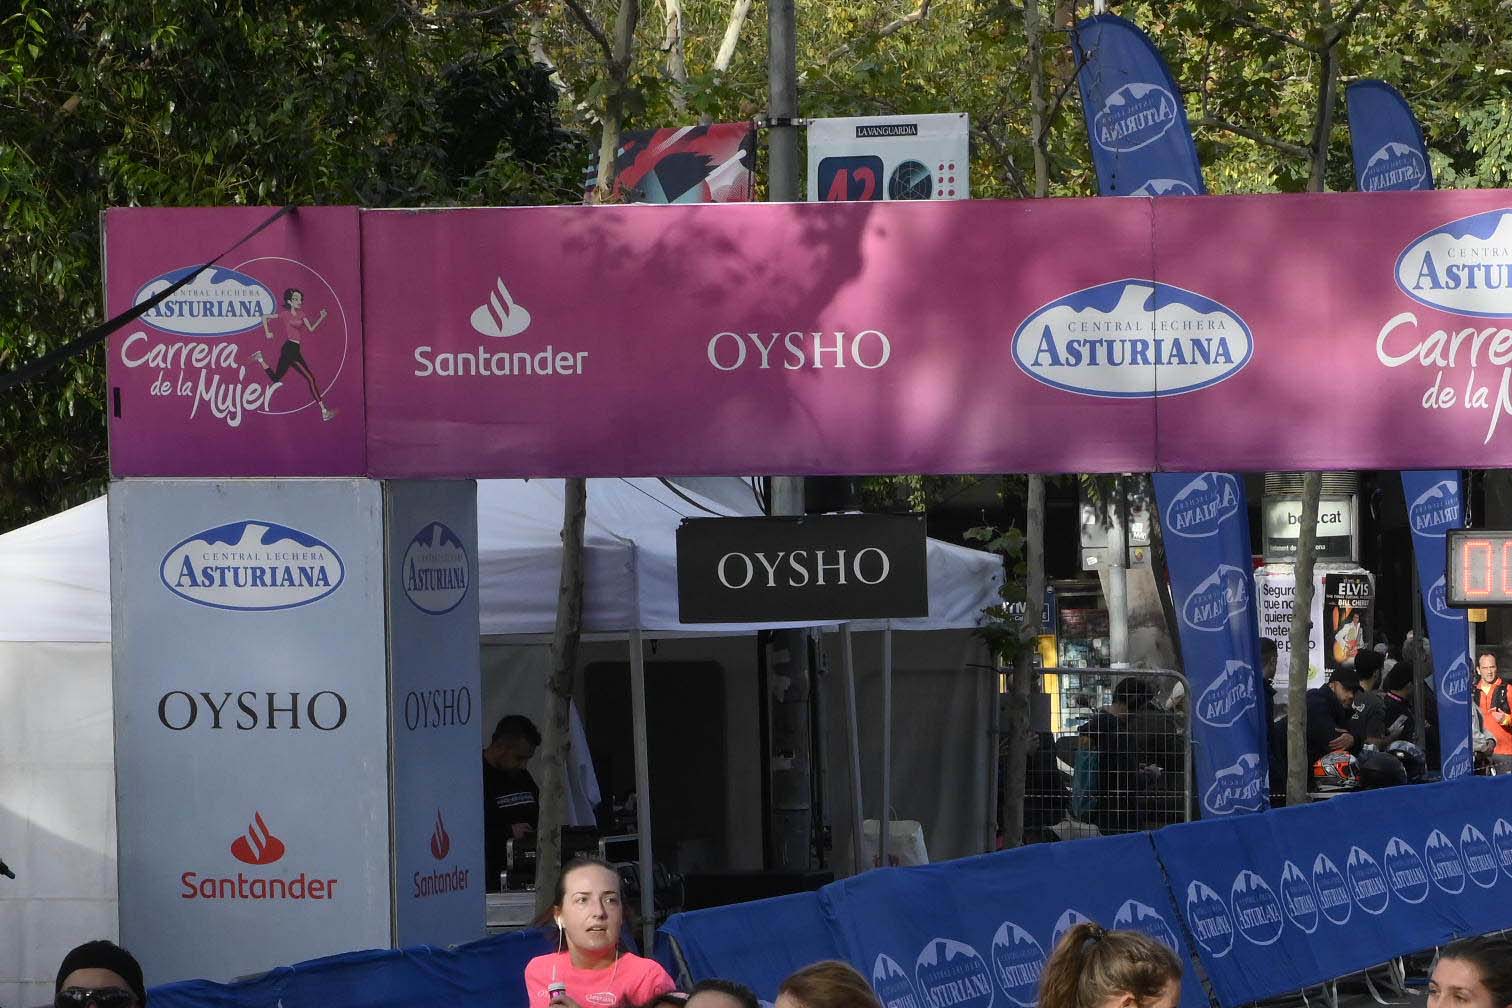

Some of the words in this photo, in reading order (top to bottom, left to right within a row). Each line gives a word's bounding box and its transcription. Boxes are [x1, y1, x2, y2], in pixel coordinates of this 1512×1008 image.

[1067, 320, 1143, 333] CENTRAL
[1150, 319, 1227, 331] LECHERA
[121, 332, 239, 368] Carrera
[414, 345, 588, 377] Santander
[707, 330, 891, 371] OYSHO
[1030, 325, 1235, 368] ASTURIANA
[150, 371, 172, 396] de
[177, 370, 193, 396] la
[190, 366, 283, 427] Mujer
[1422, 370, 1456, 409] de
[1464, 369, 1489, 409] la
[175, 555, 331, 588] ASTURIANA
[202, 551, 261, 561] CENTRAL
[266, 550, 325, 561] LECHERA
[717, 547, 890, 589] OYSHO
[407, 560, 466, 592] ASTURIANA
[1339, 583, 1369, 596] ELVIS
[1264, 601, 1280, 612] que
[1264, 611, 1293, 626] quiere
[158, 691, 347, 731] OYSHO
[404, 686, 471, 731] OYSHO
[181, 872, 337, 900] Santander
[414, 865, 469, 898] Santander
[1001, 960, 1044, 989] ASTURIAN
